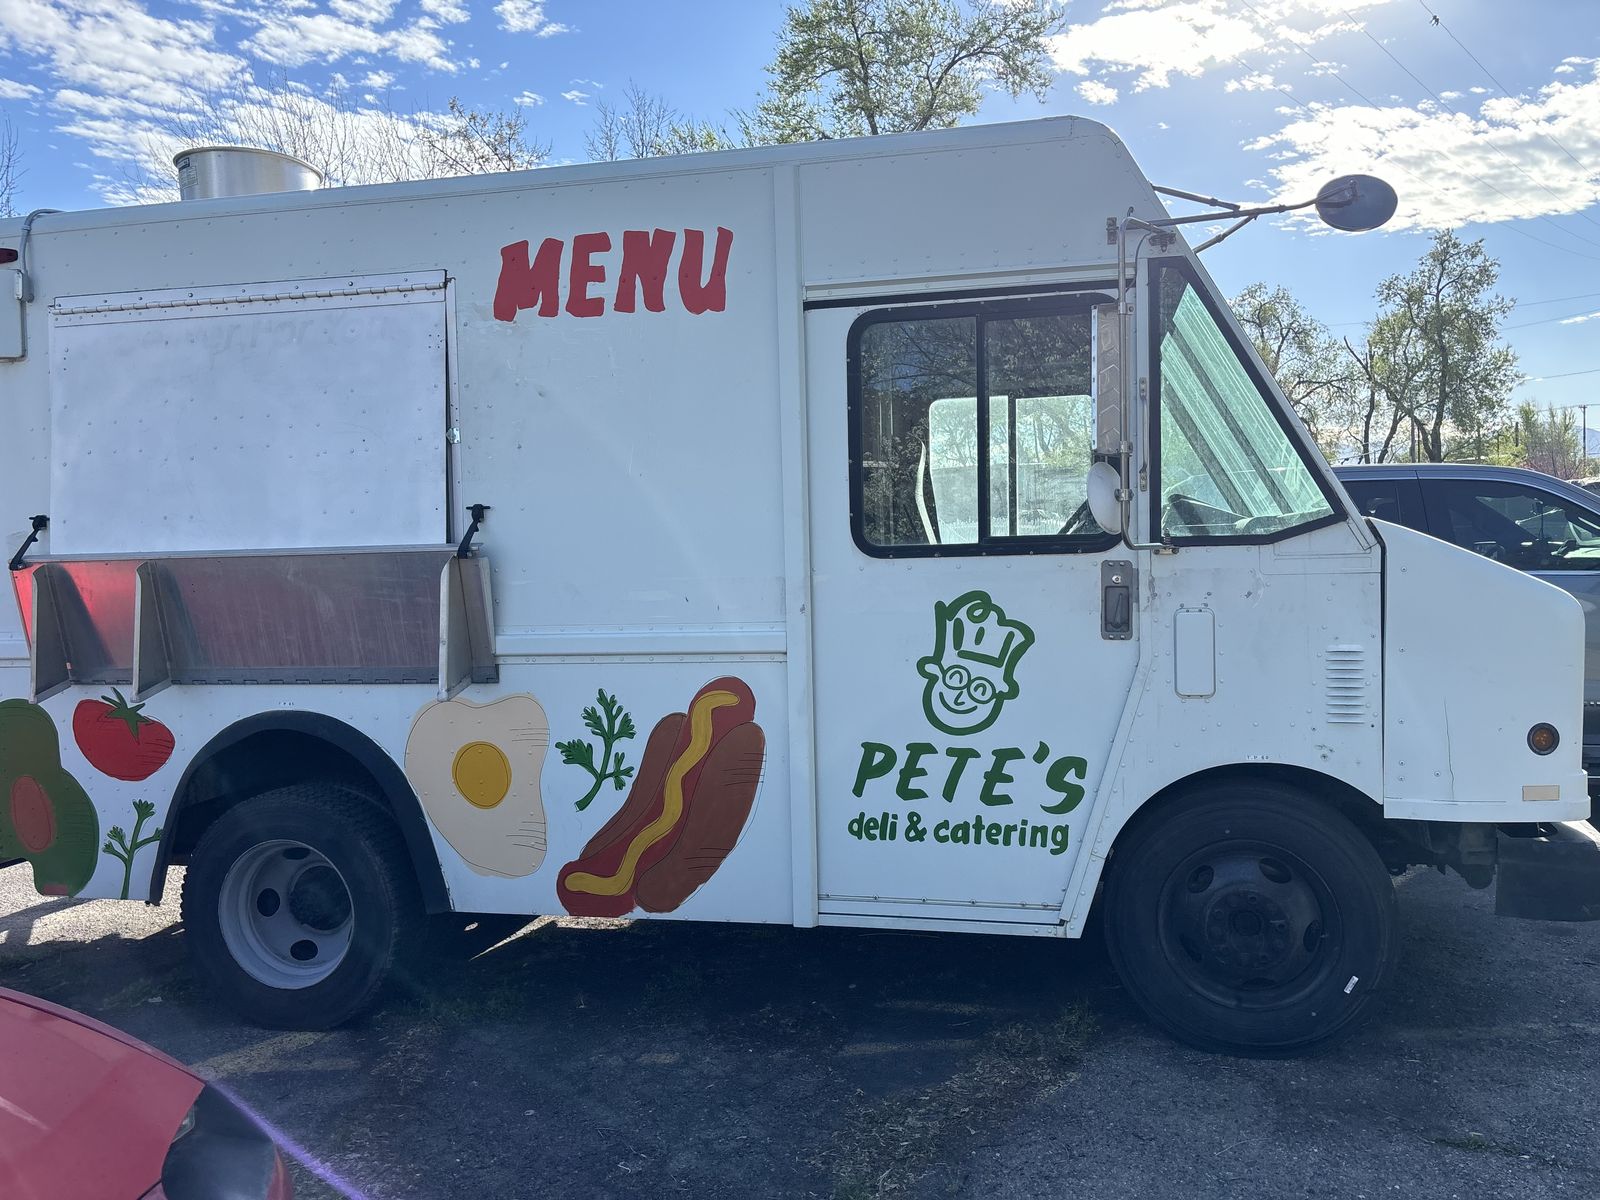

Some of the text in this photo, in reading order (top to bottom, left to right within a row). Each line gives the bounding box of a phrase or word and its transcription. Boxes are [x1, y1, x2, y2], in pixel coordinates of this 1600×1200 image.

[493, 226, 734, 322] MENU
[852, 741, 1088, 815] PETE'S
[848, 811, 1069, 856] deli & catering
